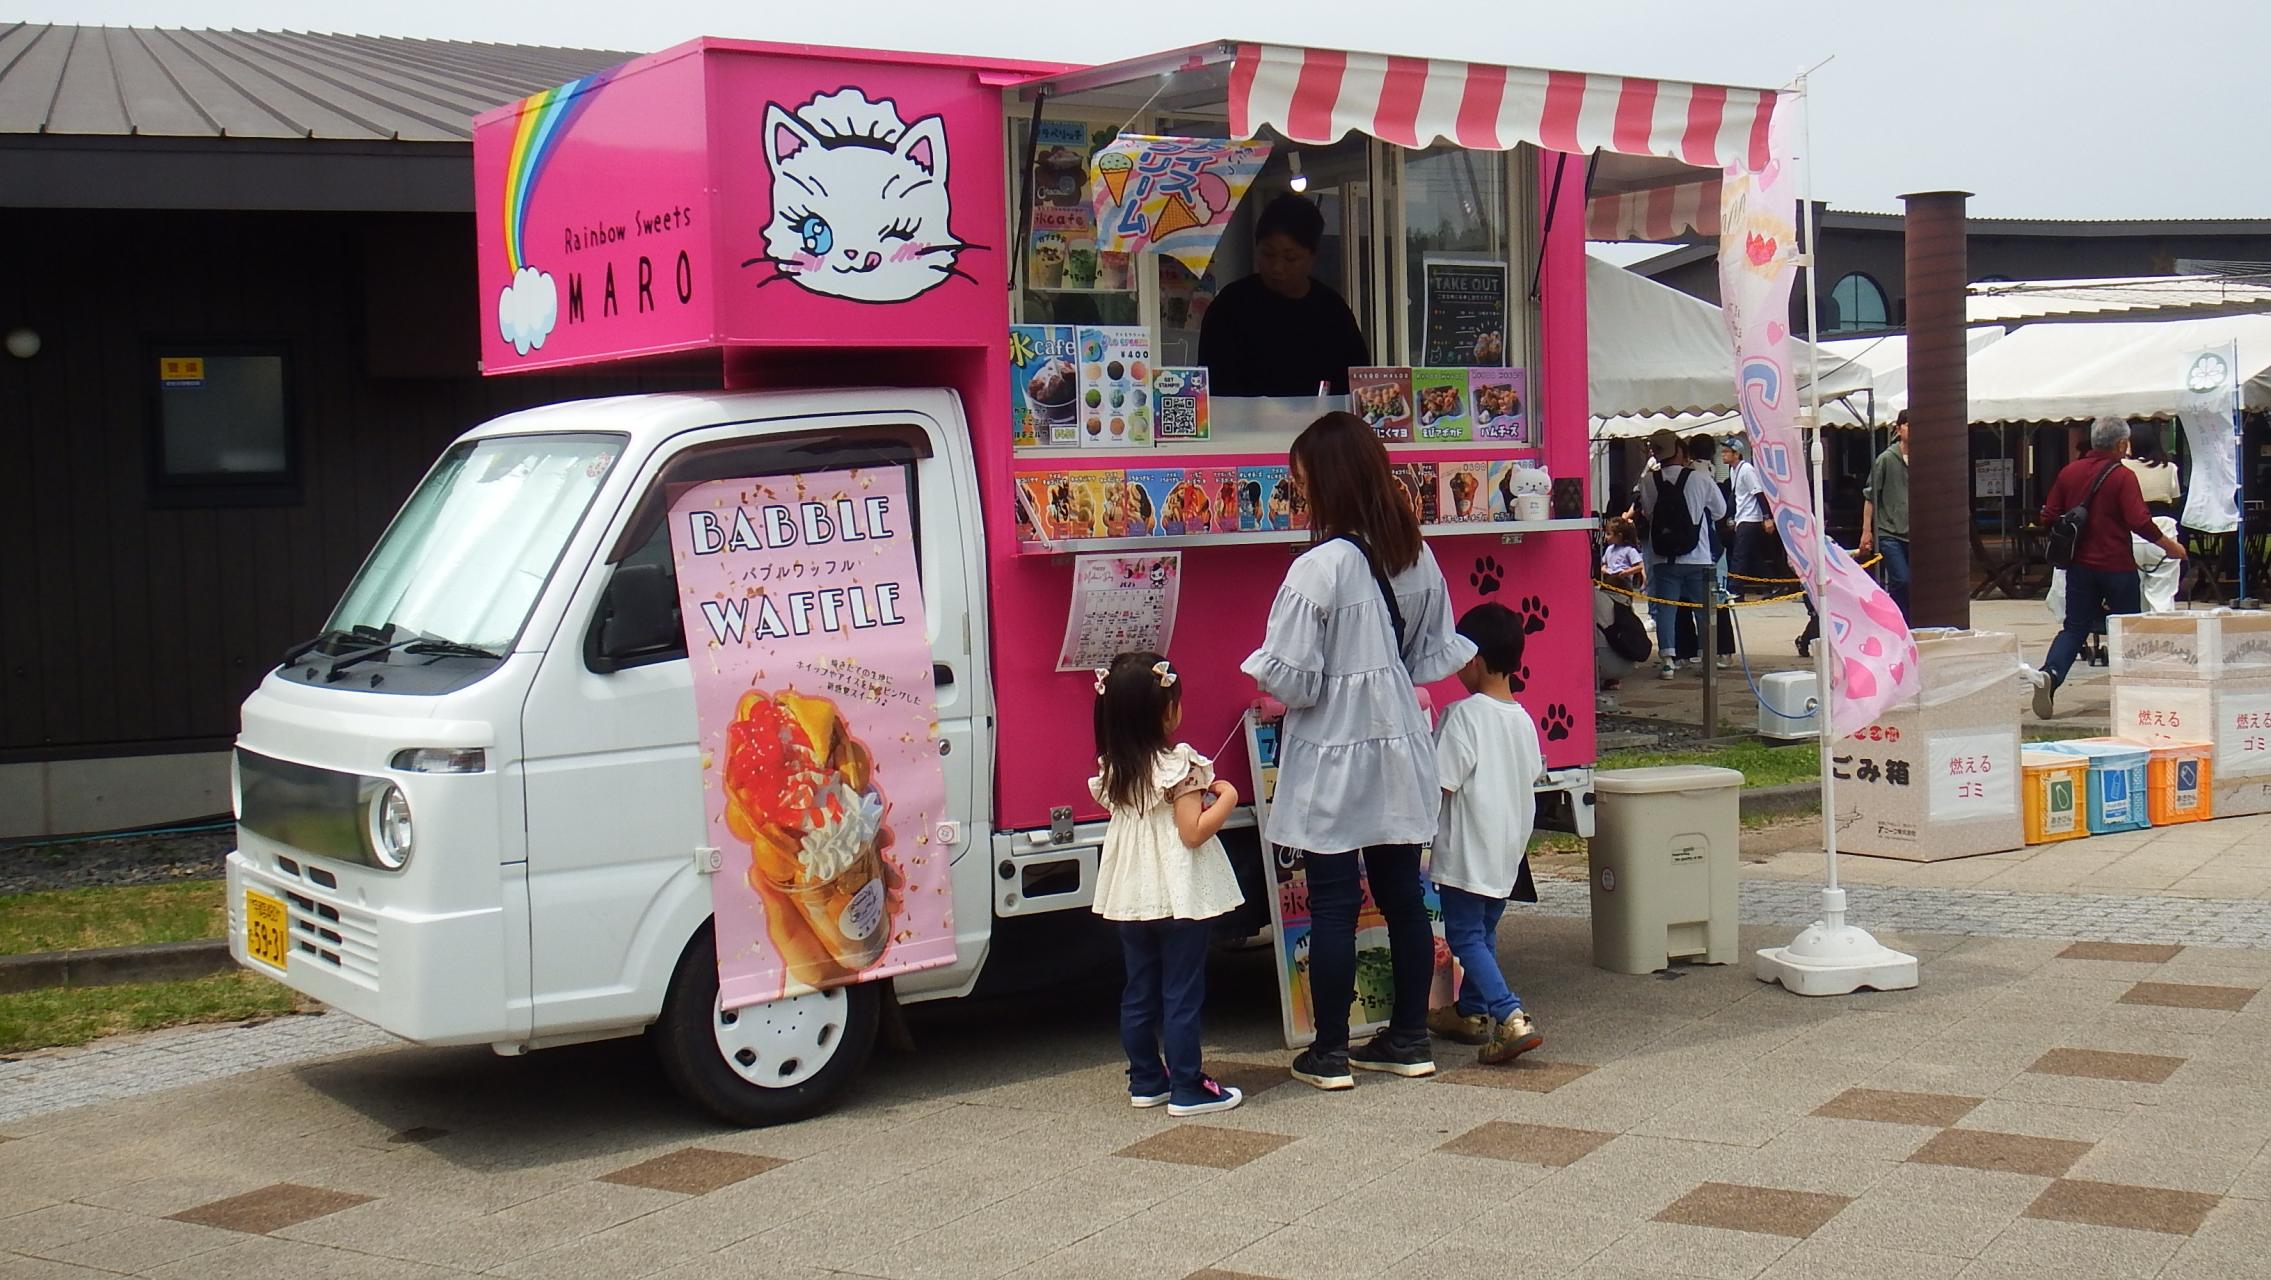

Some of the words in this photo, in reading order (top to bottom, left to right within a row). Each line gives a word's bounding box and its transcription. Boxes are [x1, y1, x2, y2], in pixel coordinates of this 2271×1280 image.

[564, 220, 627, 255] Rainbow
[635, 205, 692, 236] Sweets
[568, 249, 692, 325] MARO
[1435, 277, 1468, 291] TAKE
[1471, 278, 1500, 292] OUT
[689, 496, 894, 556] BABBLE
[741, 560, 856, 582] バブルワッフル
[700, 582, 906, 647] WAFFLE
[2138, 709, 2181, 728] 燃える
[2243, 735, 2266, 751] ゴミ
[1832, 754, 1911, 786] ごみ箱
[1949, 755, 1992, 776] 燃える
[1958, 782, 1984, 798] ゴミ
